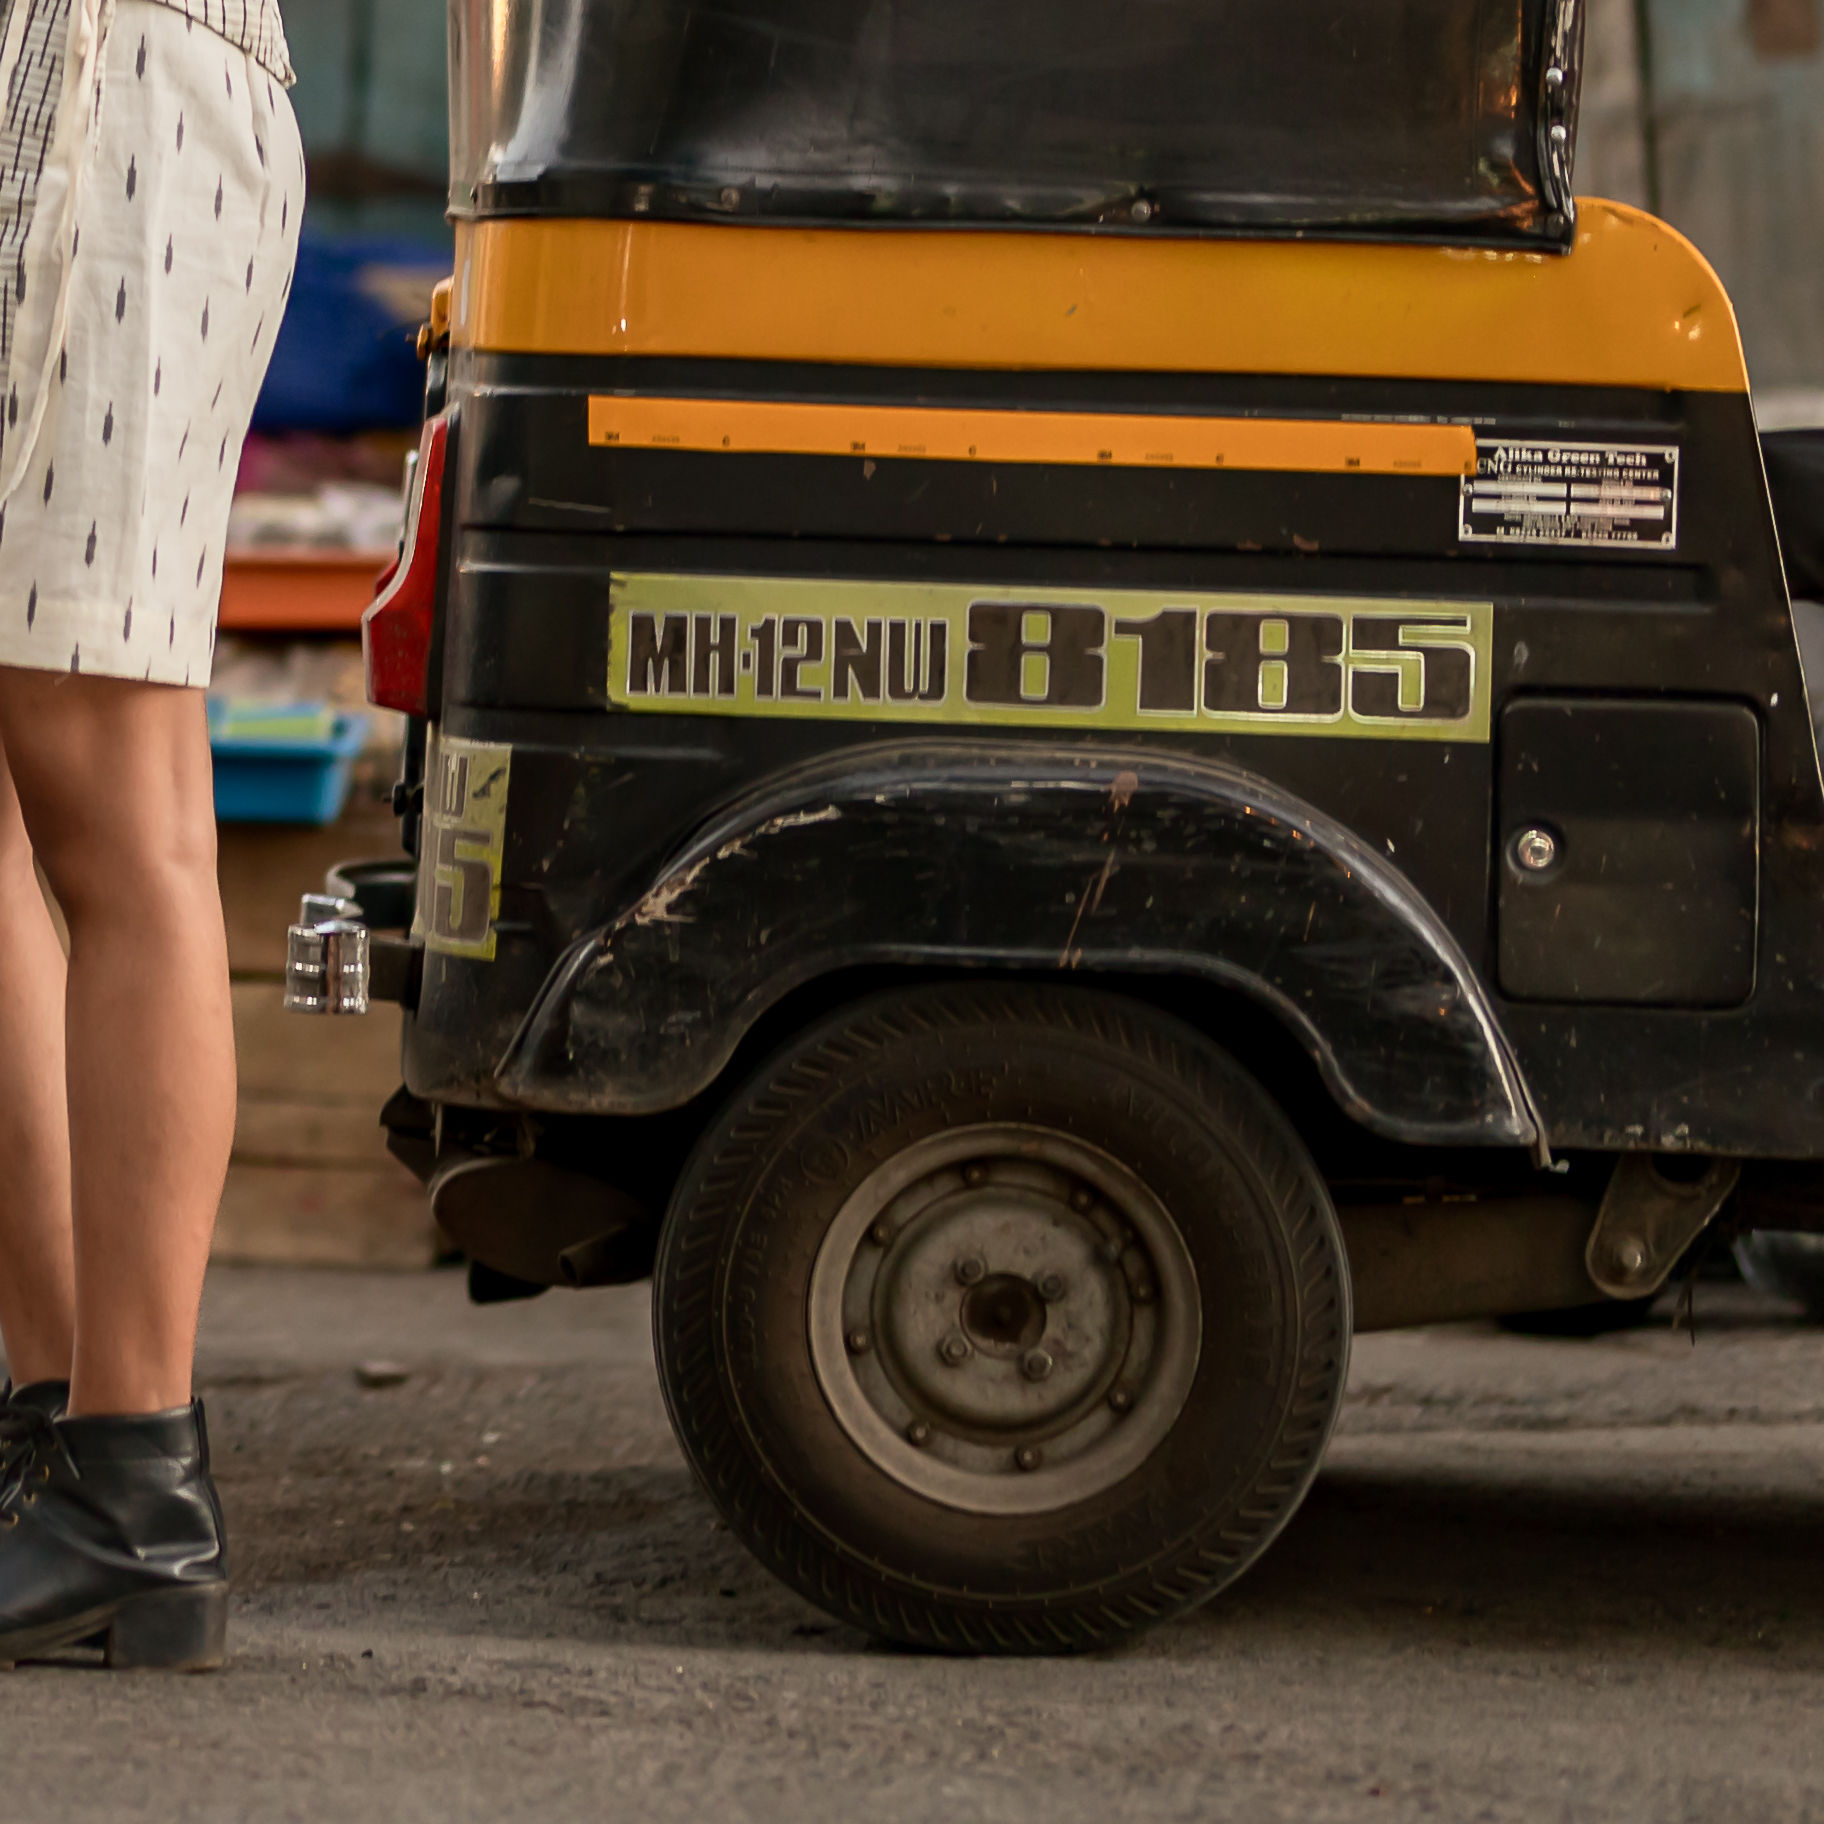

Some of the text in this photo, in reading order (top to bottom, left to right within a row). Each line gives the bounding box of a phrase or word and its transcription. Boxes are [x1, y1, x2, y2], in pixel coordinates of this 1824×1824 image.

[1476, 457, 1512, 475] CNG
[1547, 447, 1601, 466] Green
[1605, 449, 1648, 467] Tech
[963, 600, 1478, 723] 8185
